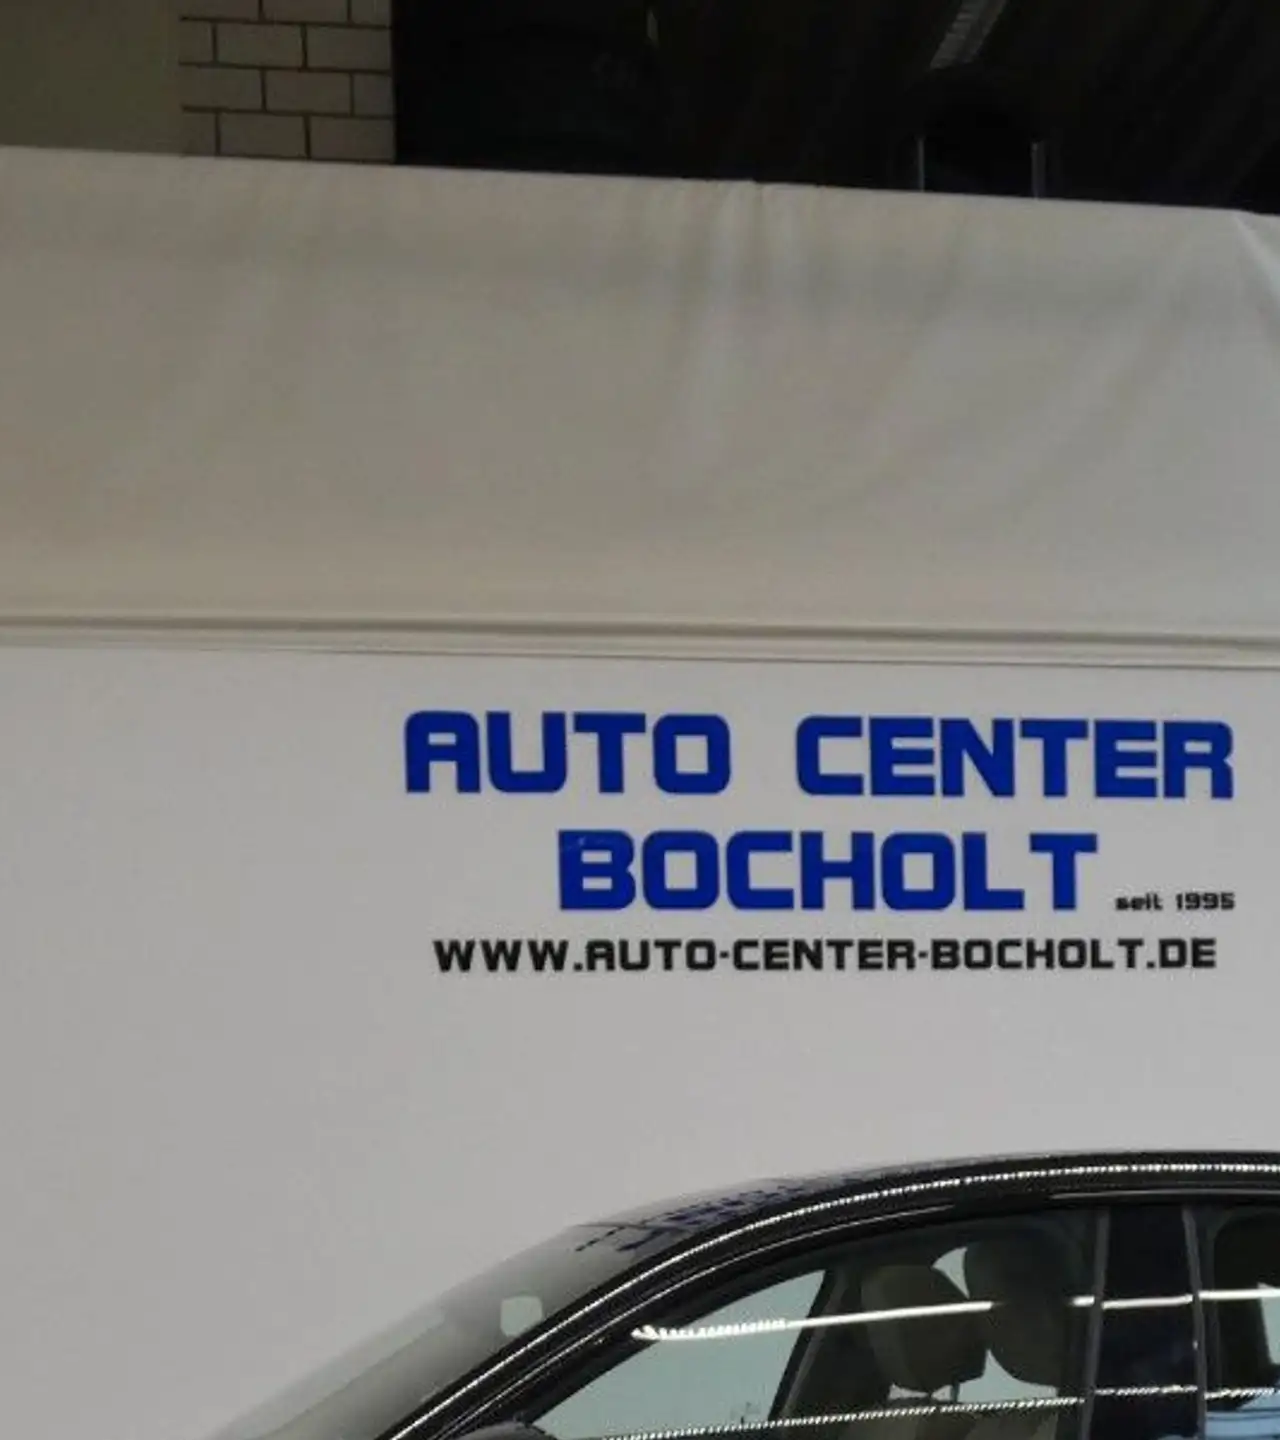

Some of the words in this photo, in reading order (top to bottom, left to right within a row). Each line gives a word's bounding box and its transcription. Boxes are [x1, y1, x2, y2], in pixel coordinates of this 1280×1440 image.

[404, 709, 732, 796] AUTO
[794, 714, 1235, 801] CENTER
[557, 828, 1099, 912] BOCHOLT
[1115, 892, 1164, 912] seit
[1175, 891, 1236, 912] 1995
[433, 937, 1217, 974] WWW.AUTO-CENTER-BOCHOLT.DE
